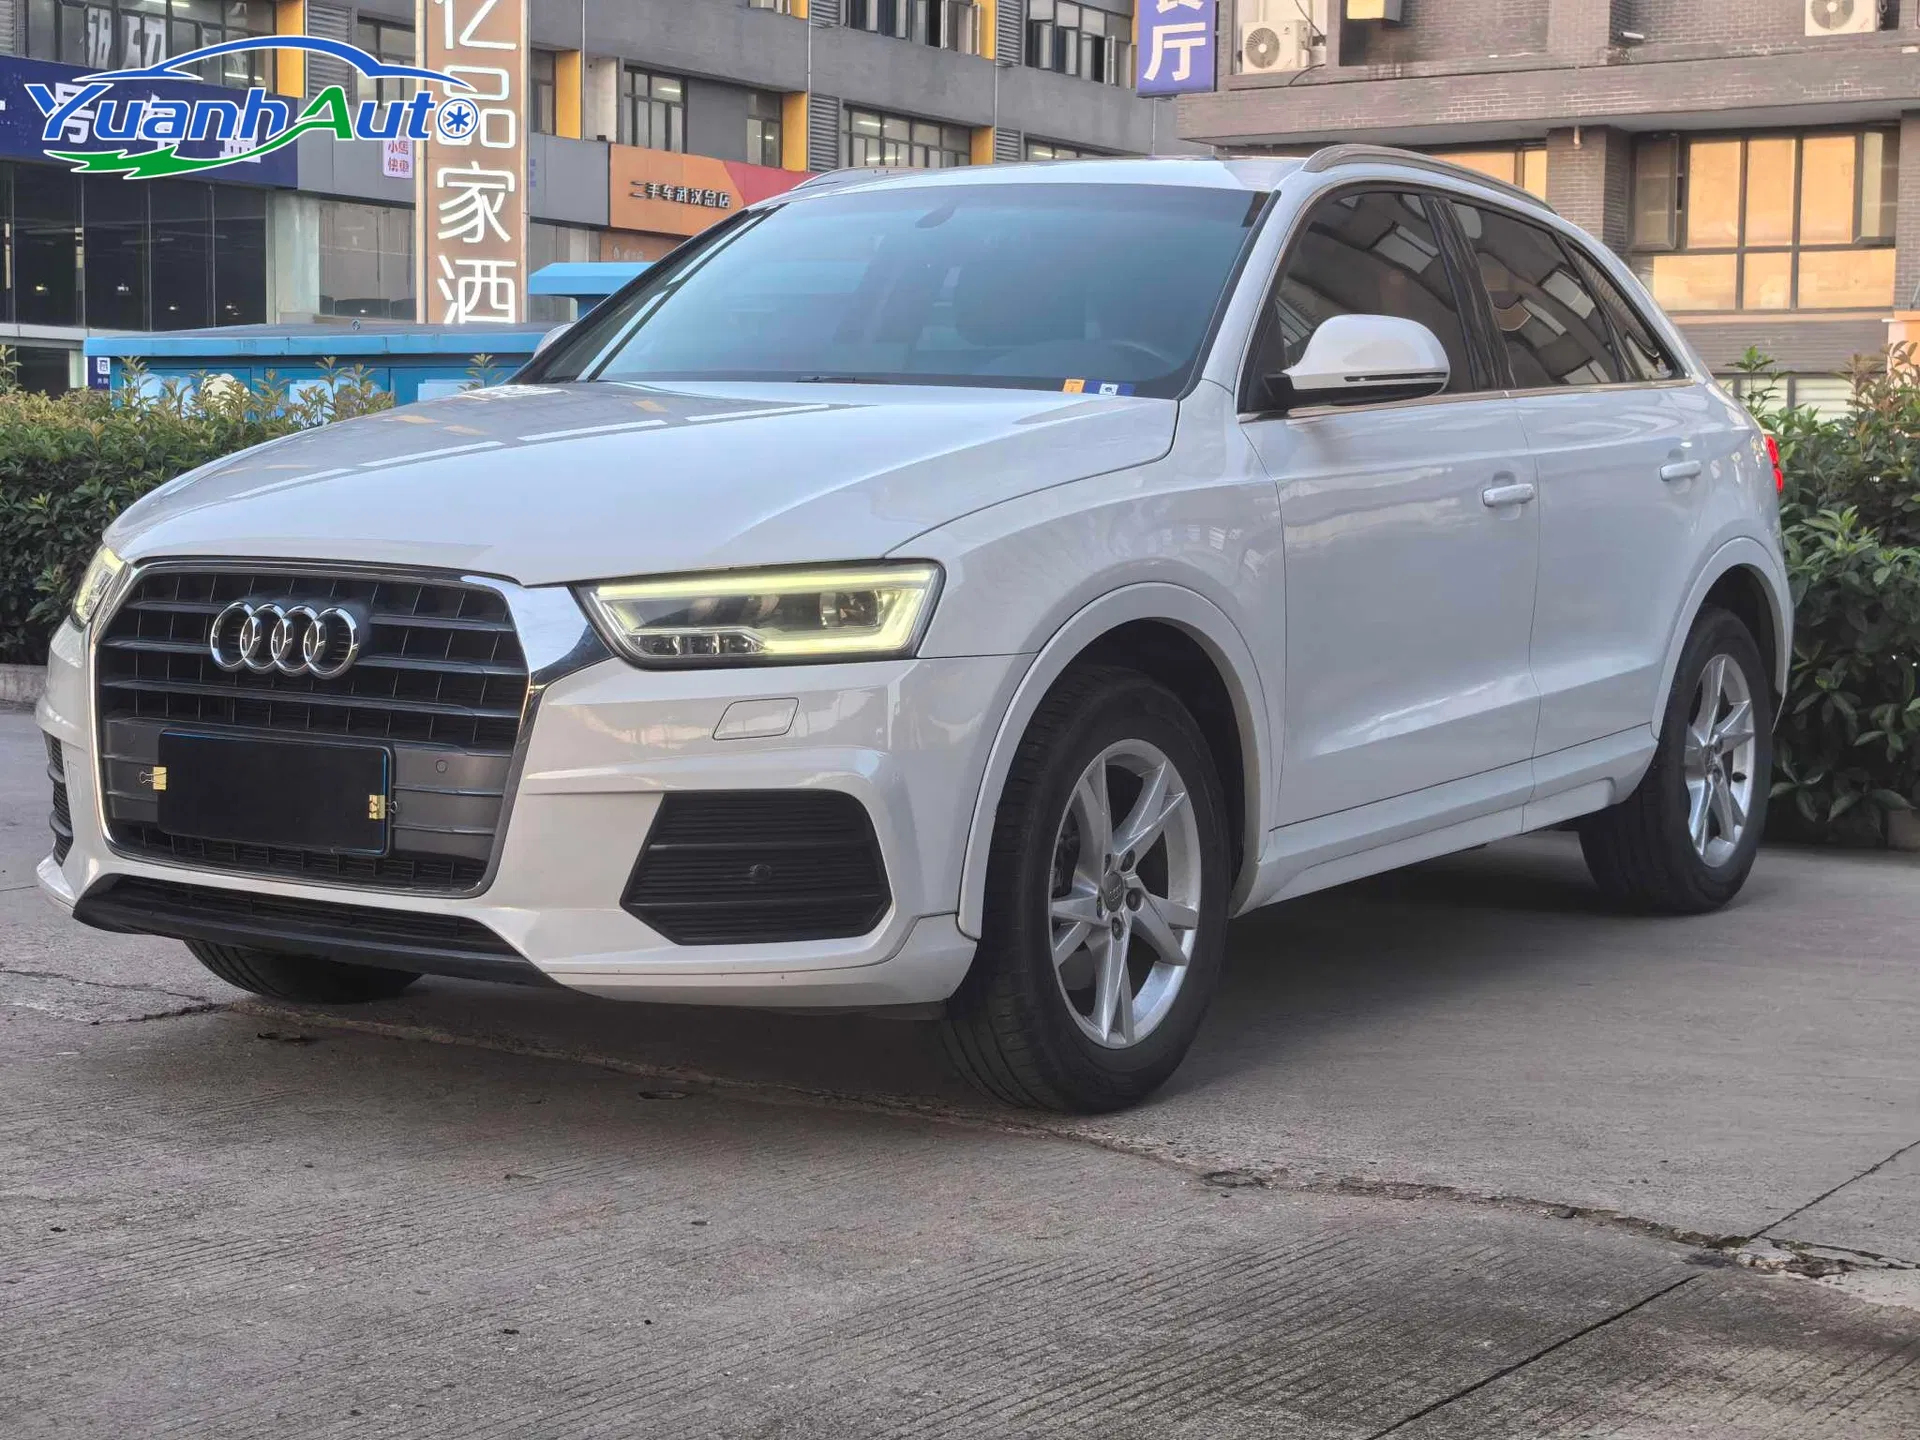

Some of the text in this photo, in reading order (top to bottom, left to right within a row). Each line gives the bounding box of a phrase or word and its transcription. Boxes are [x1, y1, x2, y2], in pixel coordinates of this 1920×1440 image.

[1143, 0, 1206, 81] 厅
[629, 181, 731, 209] 二手车武汉总店
